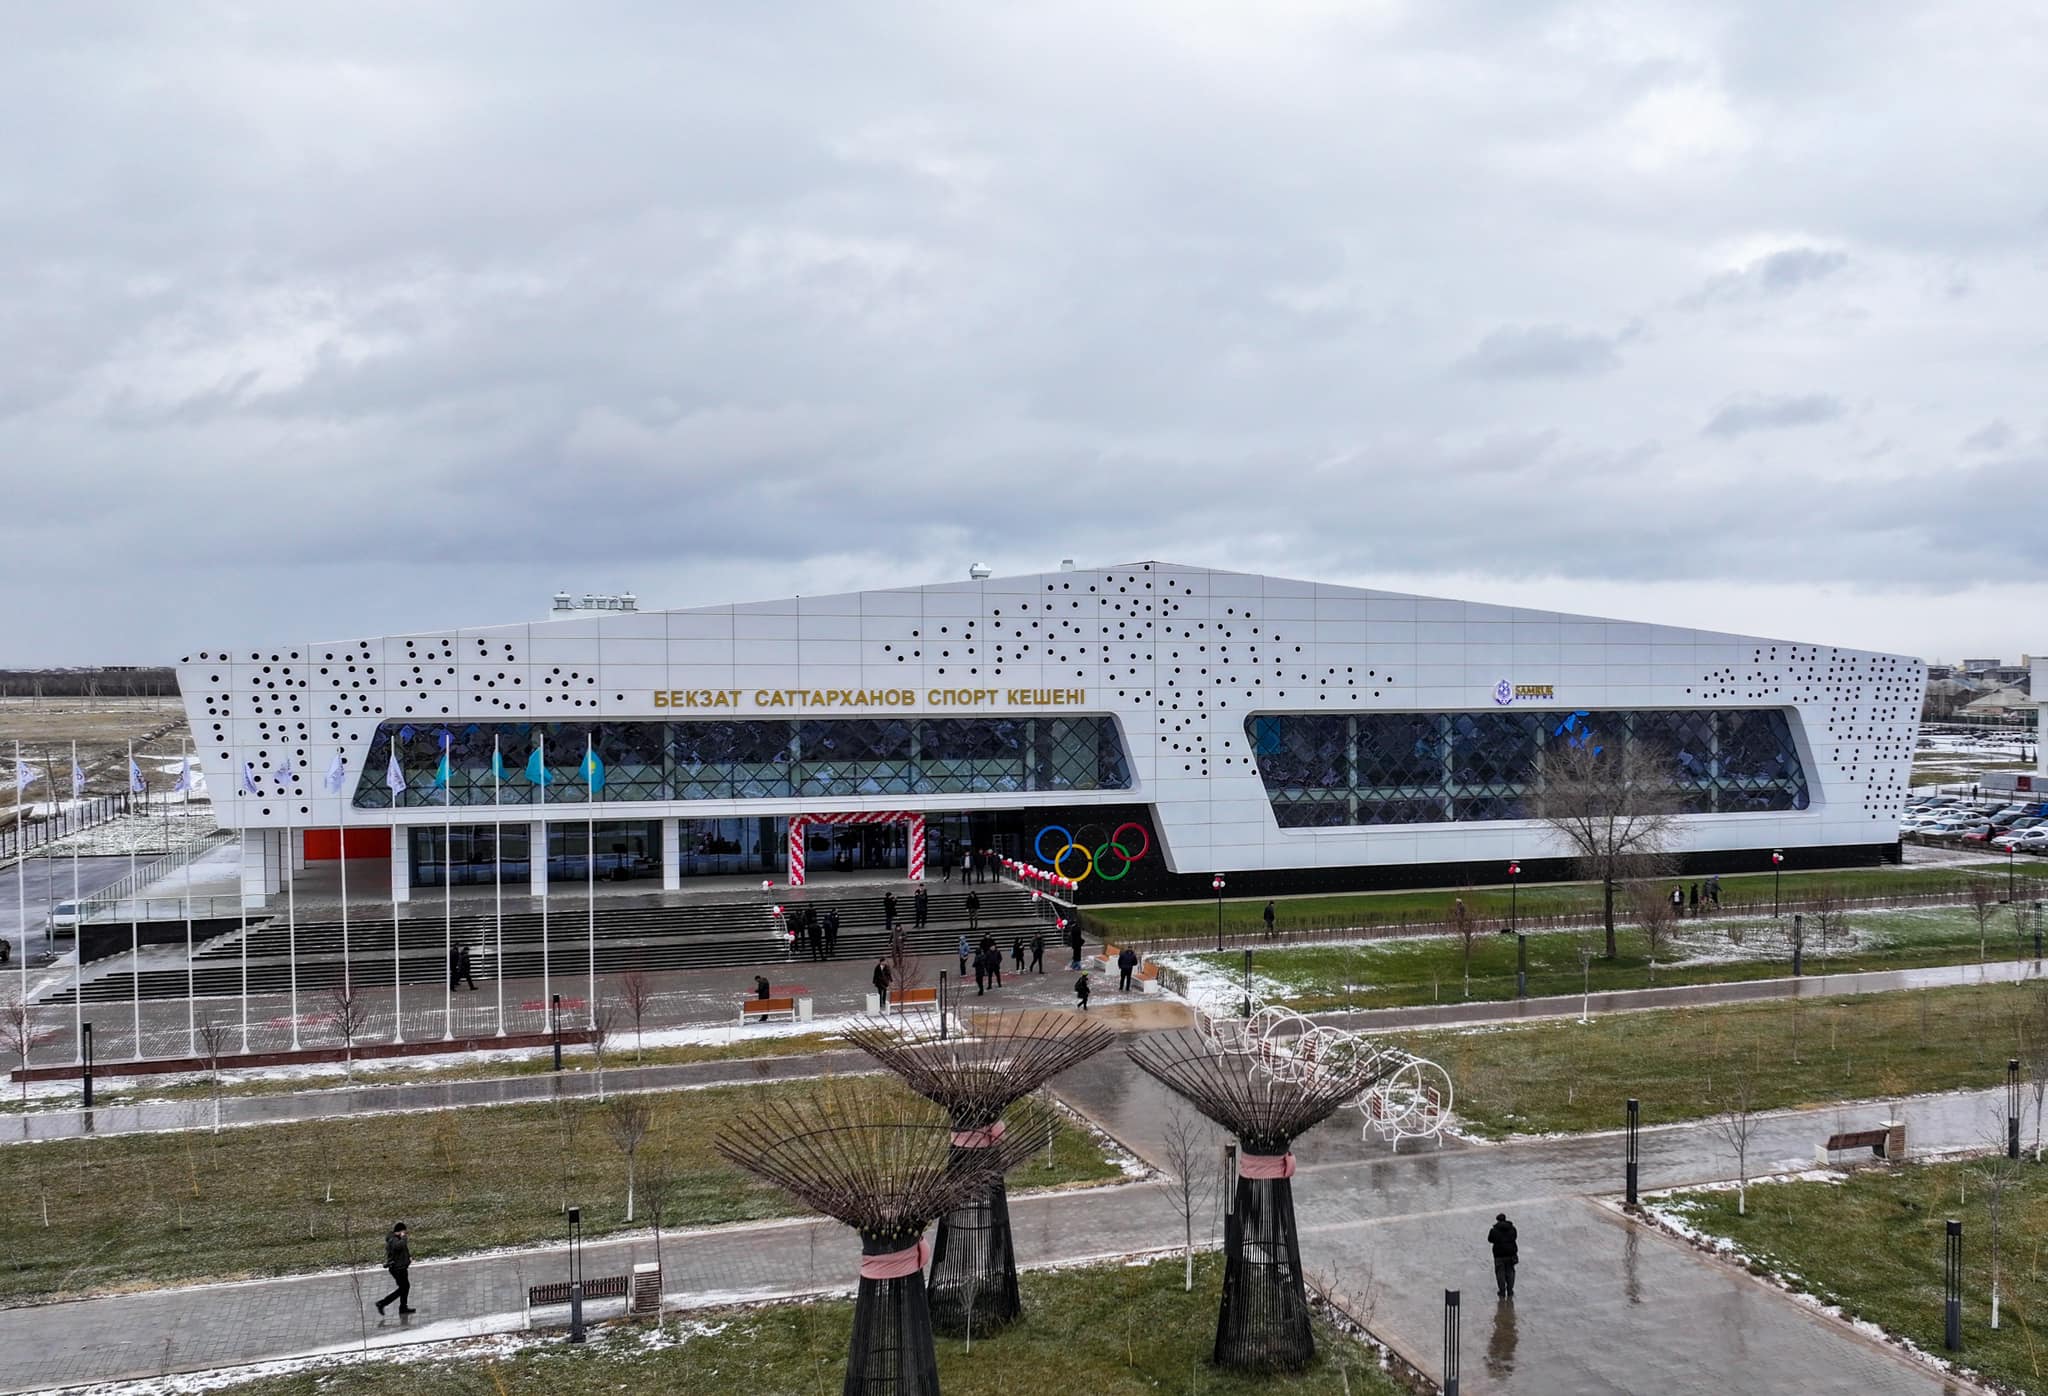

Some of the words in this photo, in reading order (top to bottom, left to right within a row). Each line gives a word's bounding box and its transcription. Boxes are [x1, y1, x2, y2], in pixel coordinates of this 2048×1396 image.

[654, 690, 741, 707] БЕКЗАТ
[754, 689, 915, 706] САТТАРХАНОВ
[927, 688, 998, 705] СПОРТ
[1007, 688, 1085, 705] КЕШЕНІ
